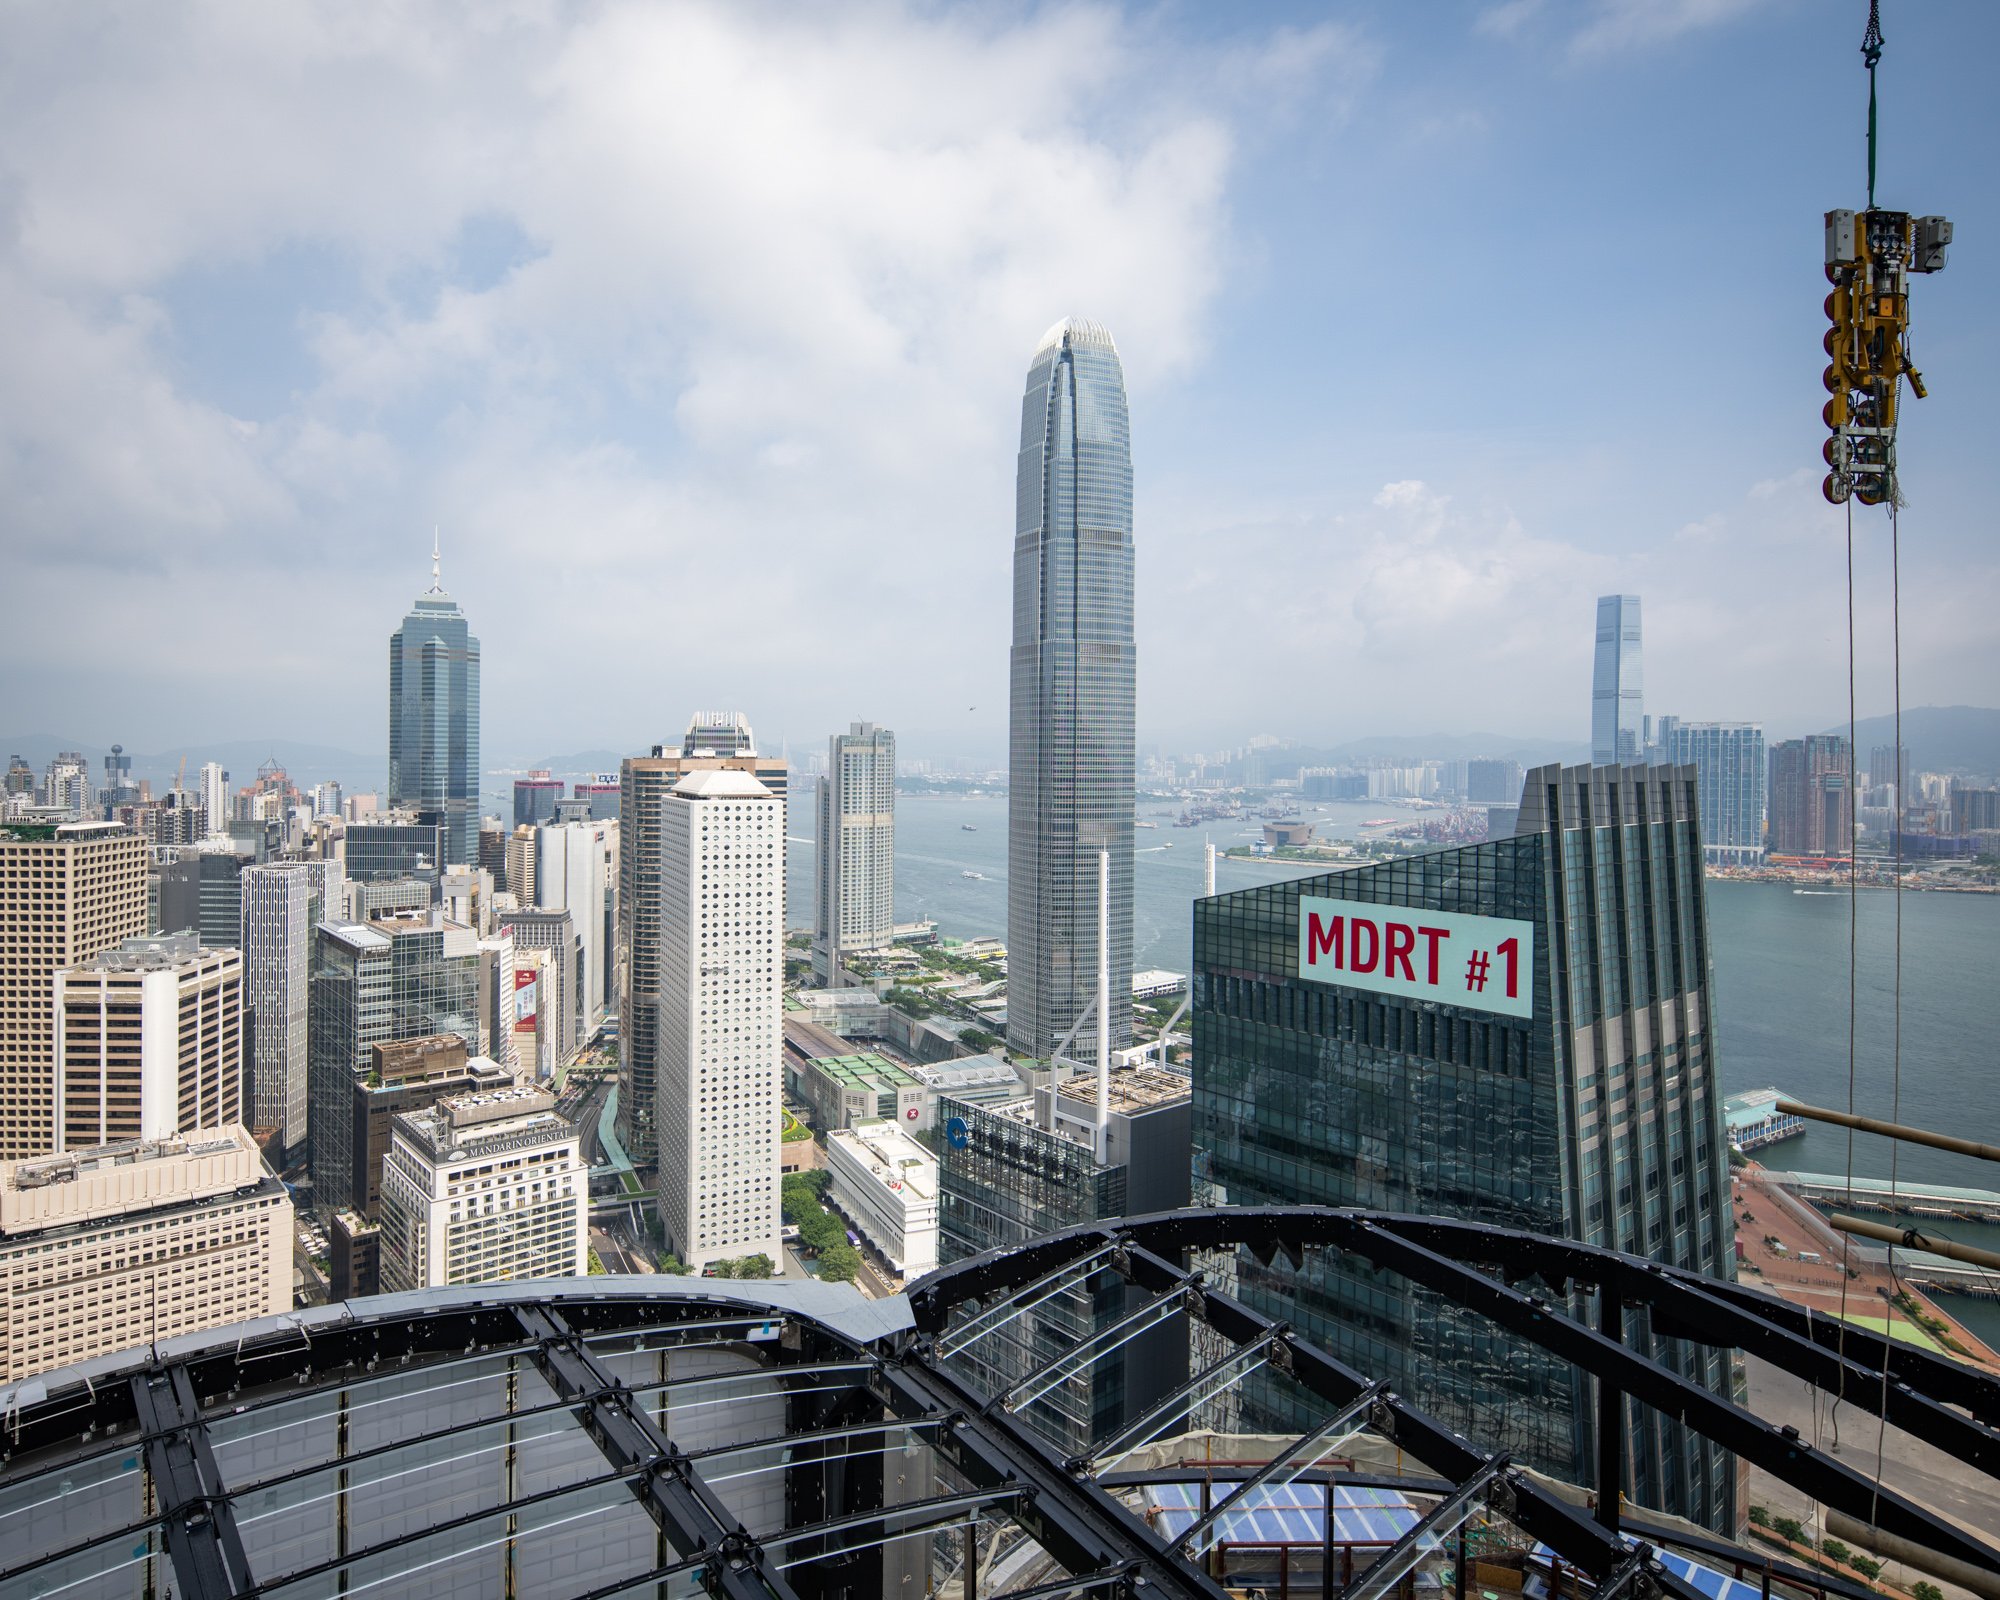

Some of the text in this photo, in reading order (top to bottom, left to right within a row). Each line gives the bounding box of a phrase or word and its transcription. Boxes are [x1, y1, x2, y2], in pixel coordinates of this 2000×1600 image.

[1308, 912, 1518, 998] MDRT #1
[469, 1129, 570, 1158] MANDARIN ORIENTAL
